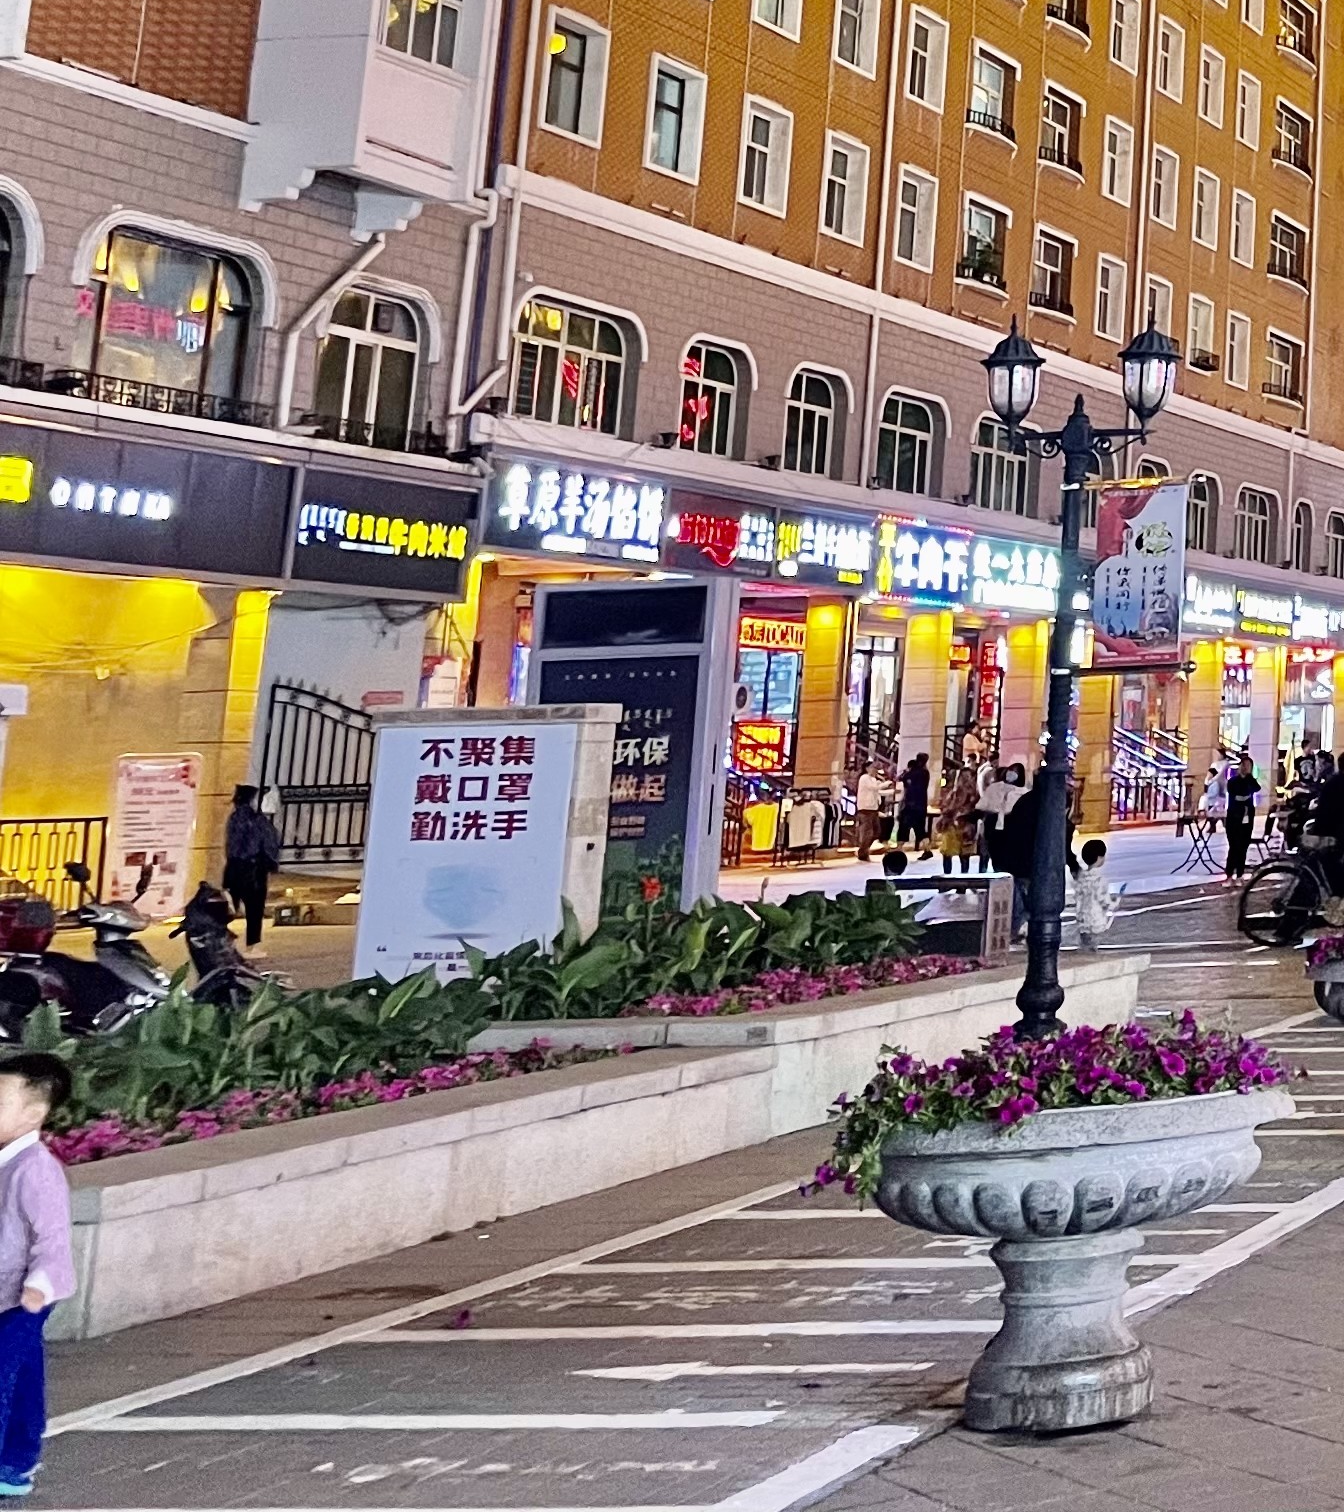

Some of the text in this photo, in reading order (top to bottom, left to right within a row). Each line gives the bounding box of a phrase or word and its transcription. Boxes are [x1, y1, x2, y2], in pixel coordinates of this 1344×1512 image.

[420, 735, 536, 767] 不聚集
[613, 735, 671, 766] 环保
[414, 773, 533, 804] 戴口罩
[410, 809, 528, 841] 勤洗手
